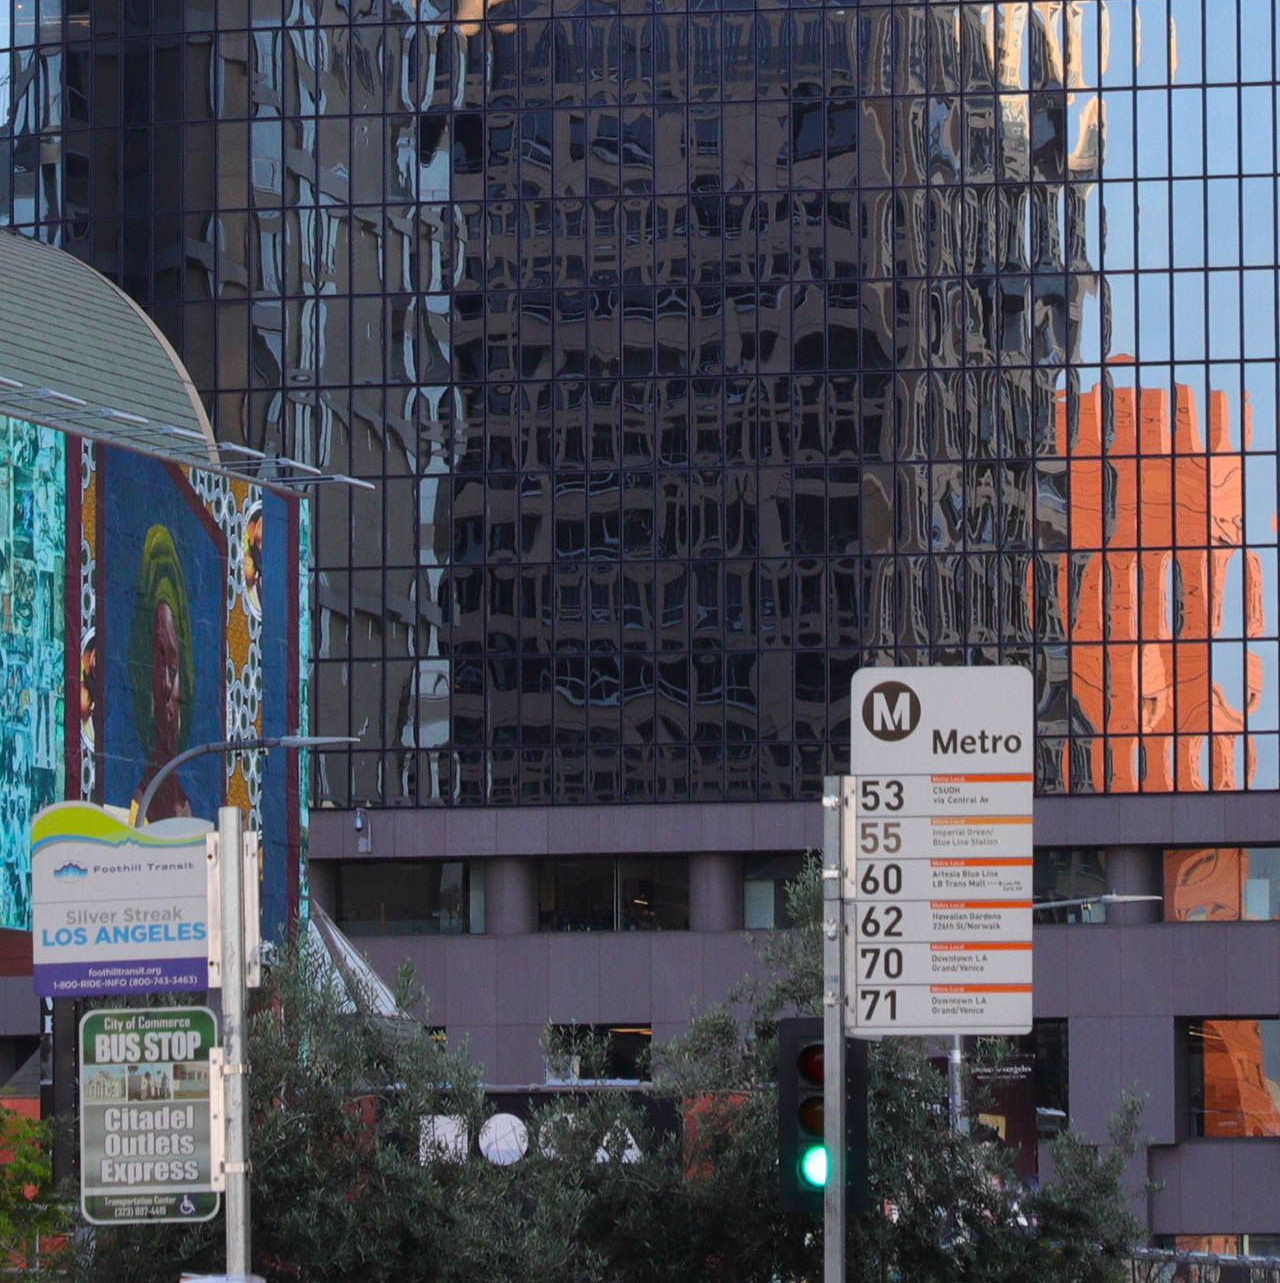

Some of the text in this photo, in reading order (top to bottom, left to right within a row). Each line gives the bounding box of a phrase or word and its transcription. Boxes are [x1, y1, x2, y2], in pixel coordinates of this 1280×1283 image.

[932, 729, 1022, 755] Metro
[860, 780, 904, 811] 53
[947, 796, 977, 804] Central
[860, 822, 902, 854] 55
[932, 829, 965, 837] Imperial
[952, 838, 969, 846] Line
[93, 862, 194, 874] Foothill Transit
[860, 864, 903, 895] 60
[66, 906, 183, 926] Silver Streak
[860, 906, 903, 937] 62
[969, 912, 1001, 920] Gardens
[42, 922, 207, 947] LOS ANGELES
[88, 967, 162, 978] foothilltransit.org
[860, 948, 903, 979] 70
[53, 978, 127, 990] 1-800-RIDE-INFO
[860, 990, 897, 1021] 71
[104, 1017, 191, 1034] City of Commerce
[95, 1031, 202, 1063] BUS STOP
[104, 1106, 195, 1132] Citadel
[105, 1132, 195, 1157] Outlets
[101, 1159, 199, 1185] Express
[105, 1196, 176, 1207] Transportation Center
